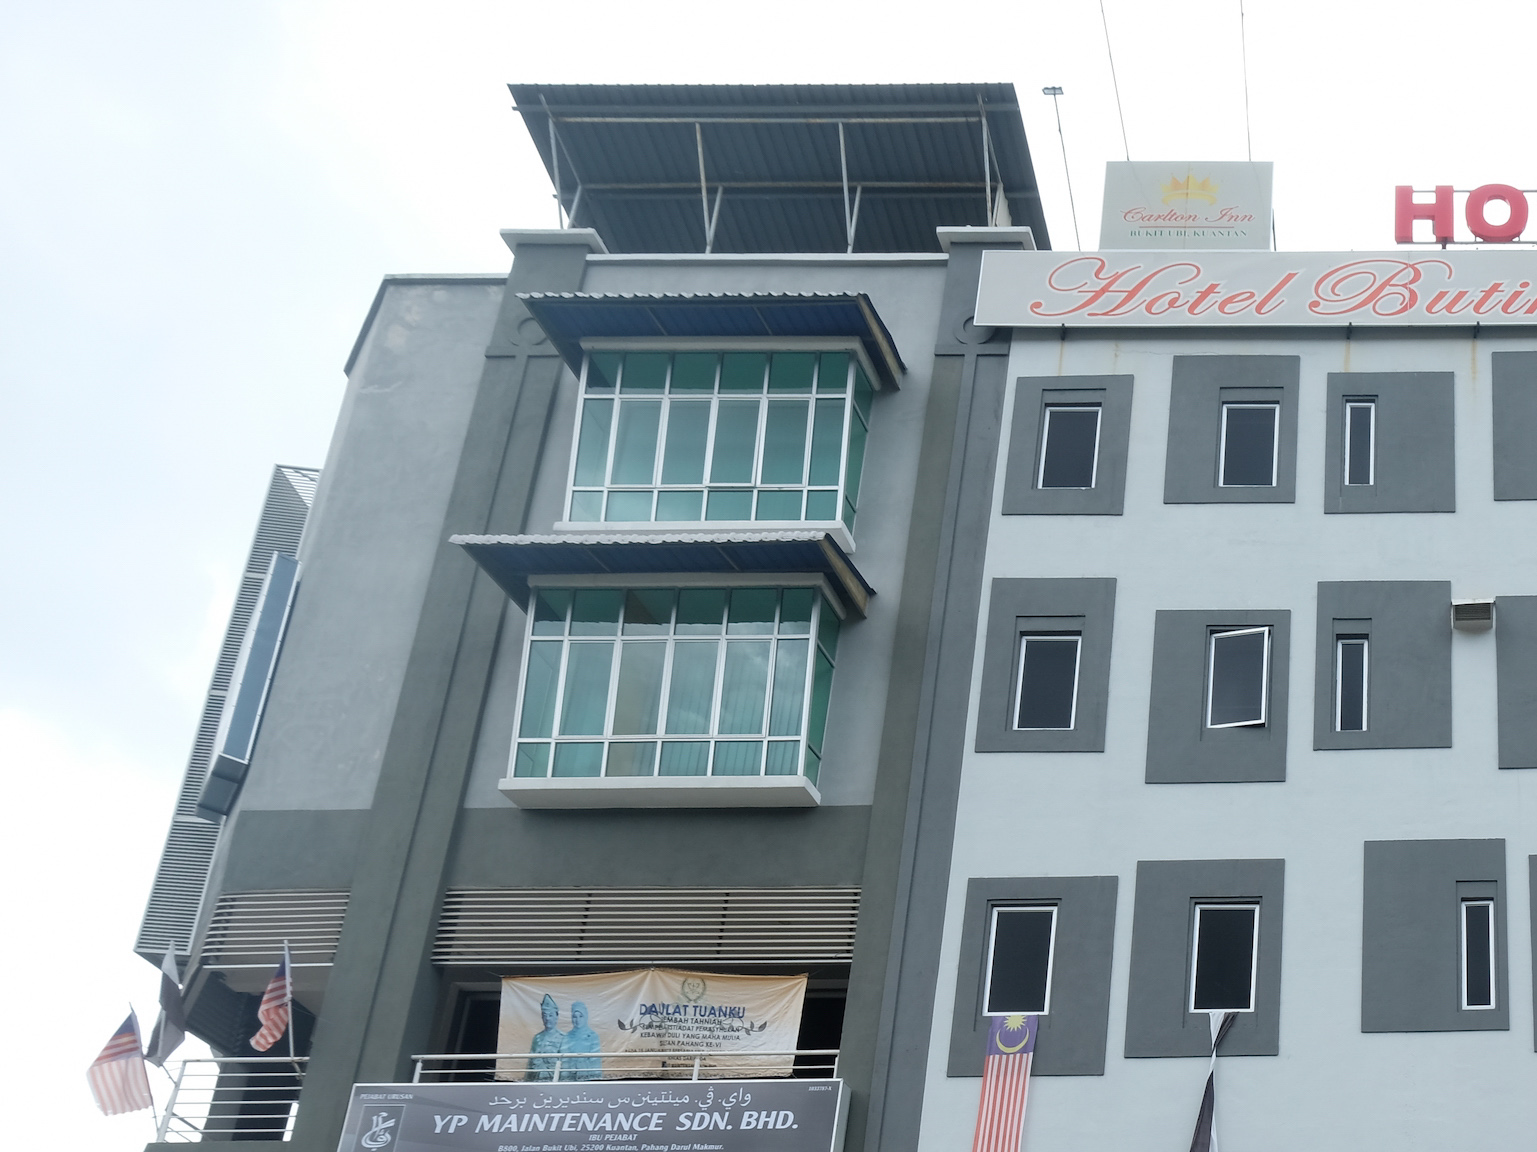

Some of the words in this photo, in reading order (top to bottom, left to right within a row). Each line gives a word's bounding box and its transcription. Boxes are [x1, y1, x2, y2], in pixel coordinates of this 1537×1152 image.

[1120, 207, 1199, 223] Carlton
[1205, 206, 1255, 223] Inn
[1029, 256, 1300, 317] Hotel
[640, 1003, 689, 1016] DAULAT
[692, 1006, 745, 1018] TUANKU
[433, 1114, 469, 1134] YP
[475, 1112, 667, 1133] MAINTENANCE
[676, 1111, 733, 1130] SDN.
[740, 1110, 799, 1129] BHD.
[564, 1144, 578, 1152] Ubi,
[606, 1144, 638, 1152] Kuantan,
[641, 1144, 668, 1152] Pahang
[670, 1143, 691, 1151] Darul
[692, 1143, 724, 1151] Makmur.
